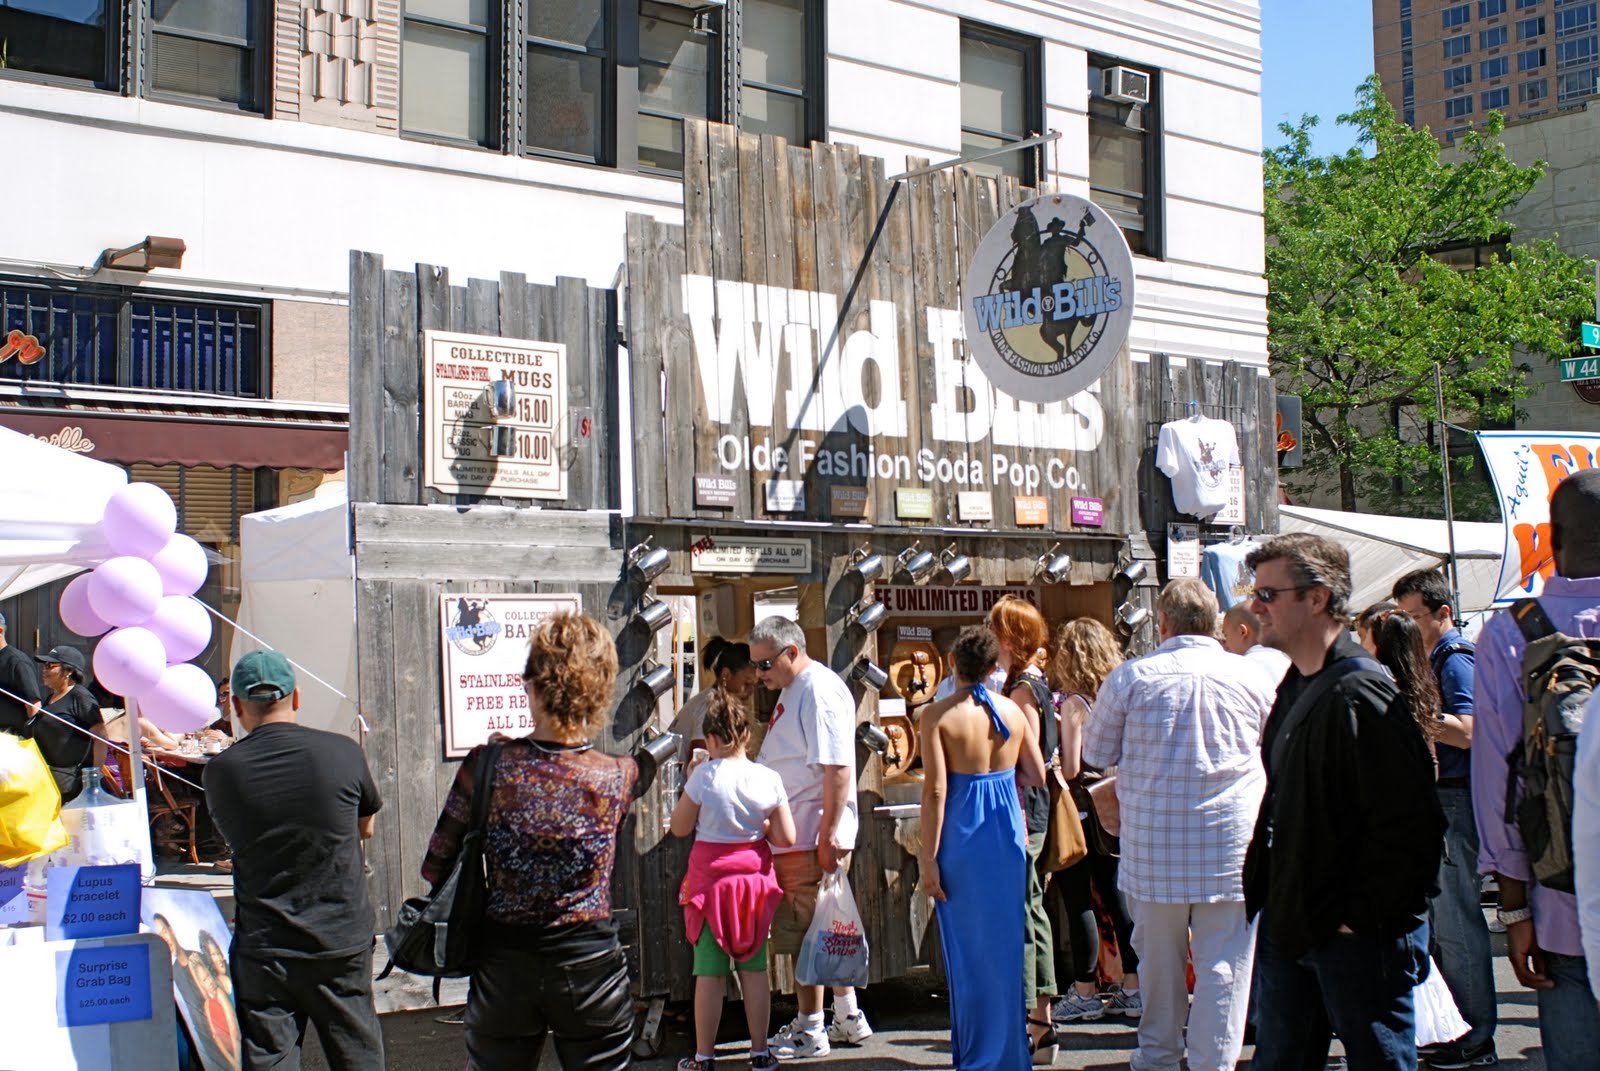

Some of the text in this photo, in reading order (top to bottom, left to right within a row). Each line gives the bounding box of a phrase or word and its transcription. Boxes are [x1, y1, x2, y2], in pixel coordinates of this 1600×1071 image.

[973, 275, 1122, 332] Wild Bill's
[451, 346, 543, 367] COLLECTIBLE
[680, 274, 908, 438] Wild
[993, 332, 1010, 358] OLDE
[1008, 355, 1045, 375] FASHION
[1048, 359, 1071, 375] SODA
[1072, 343, 1088, 361] POP
[436, 363, 490, 382] STAINLESS STEEL
[1565, 359, 1598, 378] W 44
[501, 369, 552, 389] MUGS
[447, 400, 480, 410] BARREL
[513, 398, 548, 424] 15.00
[454, 410, 474, 419] MUG
[28, 426, 96, 453] ille
[490, 467, 519, 475] RFILLS
[718, 434, 1087, 496] Olde Fashion Soda Pop Co.
[500, 476, 539, 484] PURCHASE
[697, 478, 716, 489] Wild
[776, 547, 788, 556] ALL
[791, 548, 803, 556] DAY
[875, 588, 893, 611] EE
[896, 588, 978, 612] UNLIMITED
[460, 673, 523, 689] STAINLES
[467, 695, 504, 711] FREE
[487, 714, 536, 730] ALL DA
[78, 877, 113, 889] Lupus
[71, 890, 120, 902] bracelet
[63, 911, 126, 924] $2.00 each
[79, 960, 128, 974] Surprise
[76, 975, 131, 988] Grab Bag
[79, 996, 130, 1008] $25.00 each
